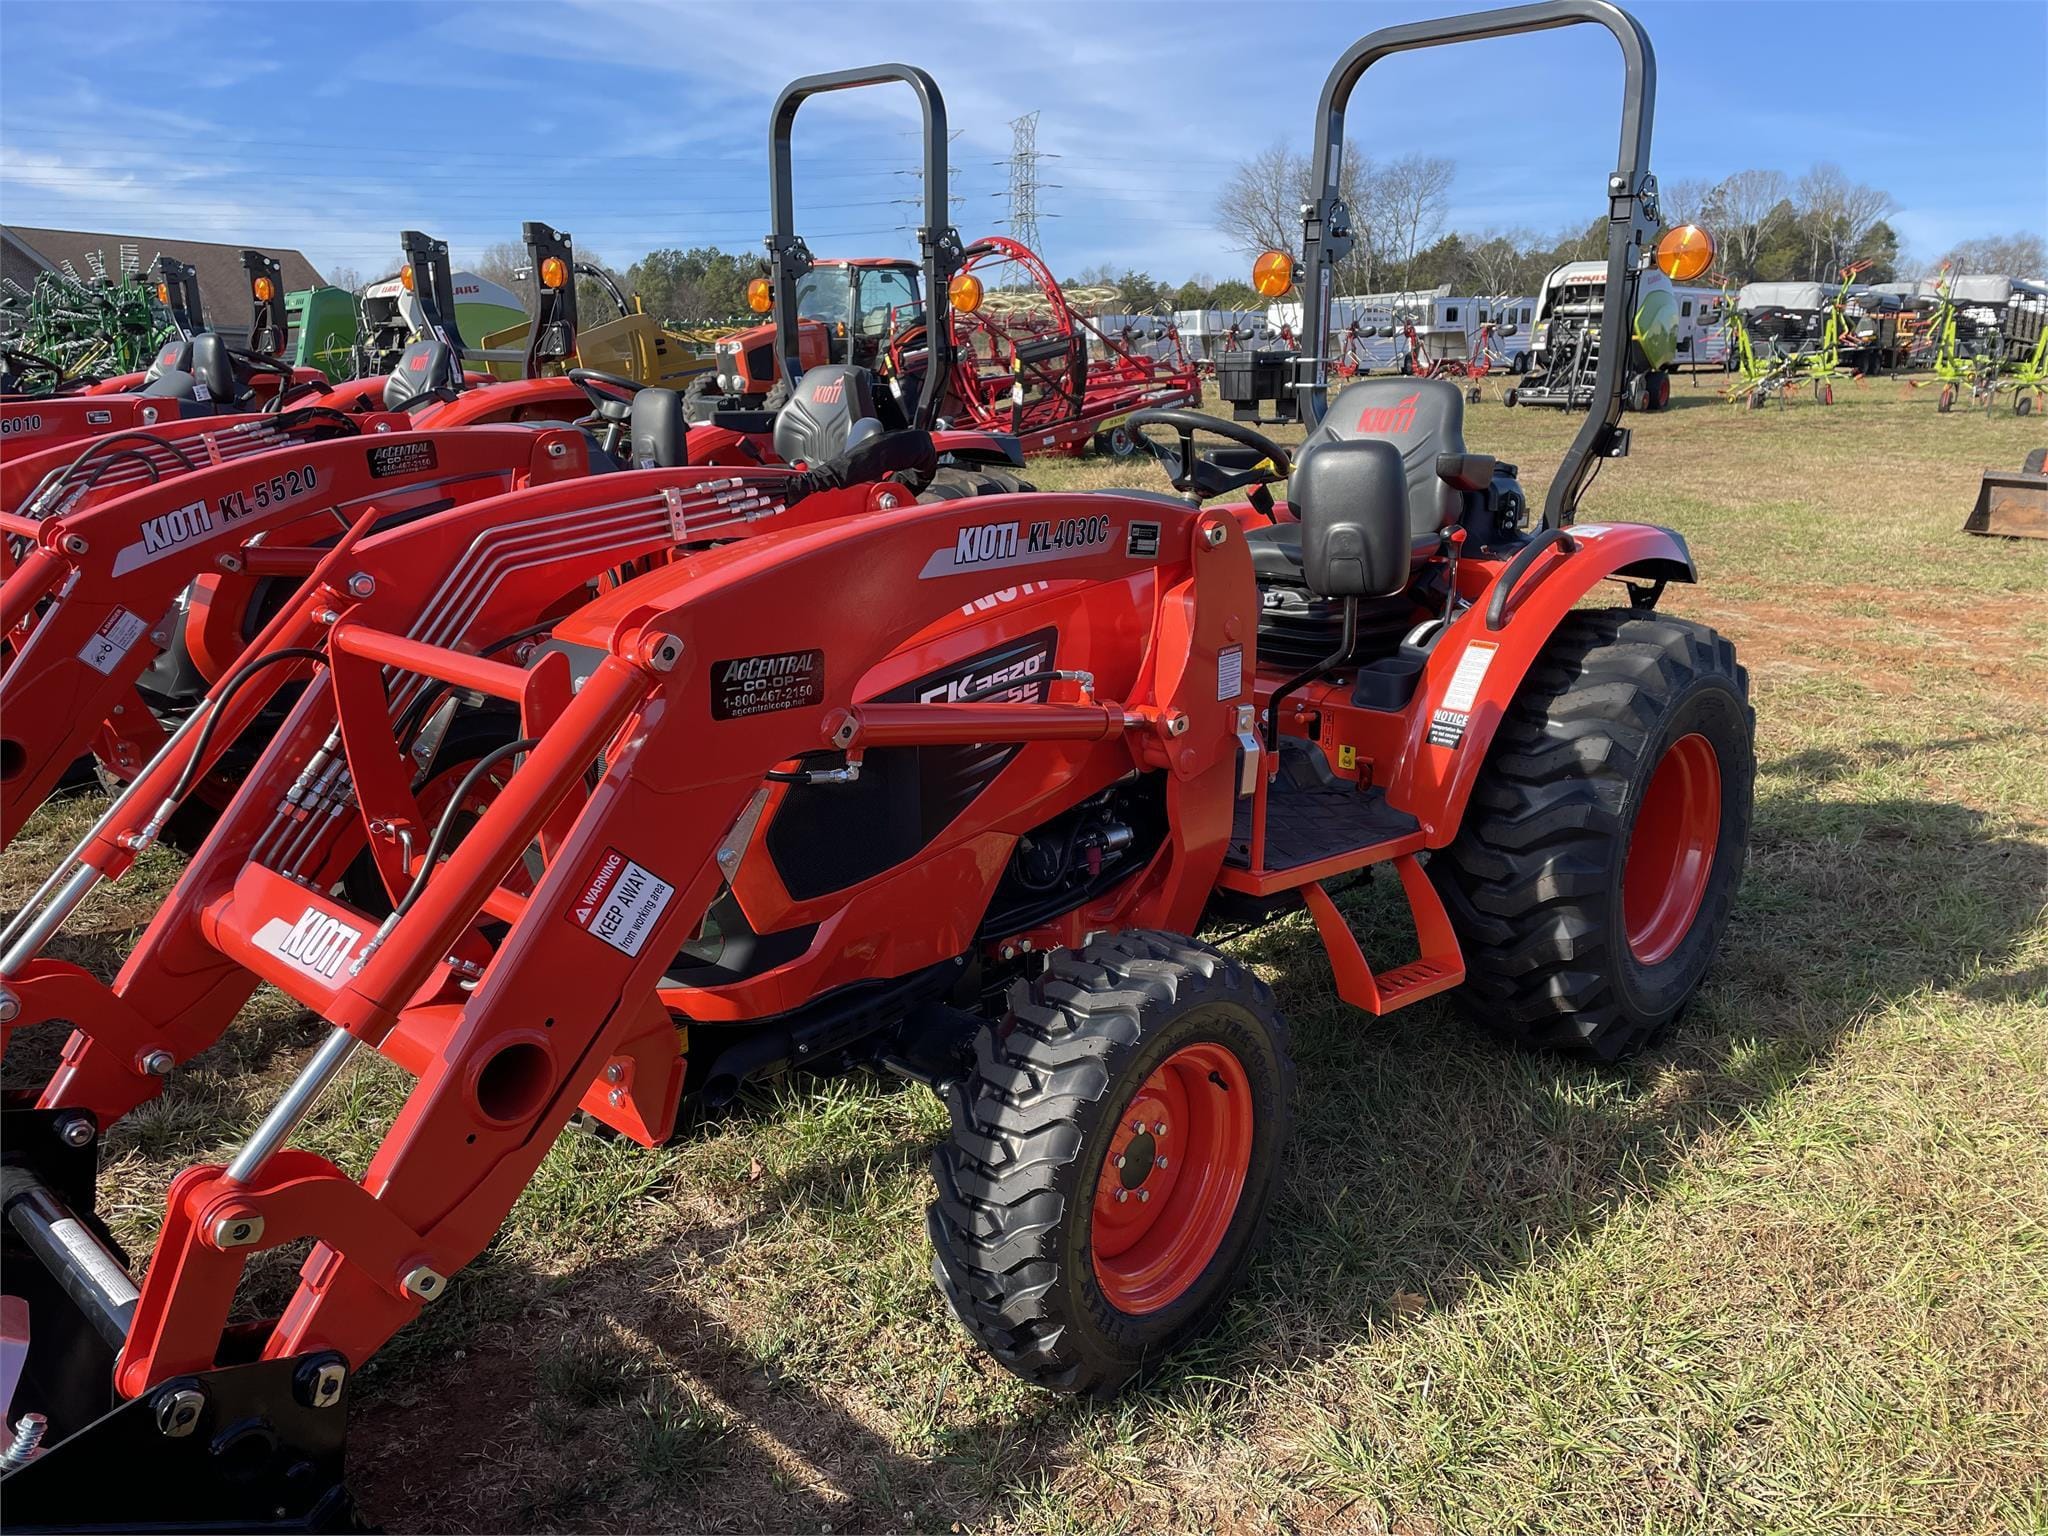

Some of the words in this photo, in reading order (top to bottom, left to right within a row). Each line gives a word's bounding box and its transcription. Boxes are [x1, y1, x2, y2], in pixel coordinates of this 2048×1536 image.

[813, 384, 842, 403] KIOTI
[1356, 405, 1418, 433] KIOTI
[141, 498, 213, 554] KIOTI
[954, 520, 1020, 565] KIOTI
[1027, 515, 1110, 553] KL4030C
[723, 684, 813, 709] 1-800-467-2150
[731, 698, 806, 717] agcentralcoop.net
[1433, 709, 1470, 725] NOTICE
[582, 854, 621, 905] WARNING
[596, 905, 624, 940] KEEP
[616, 868, 647, 908] AWAY
[619, 929, 638, 950] from
[632, 900, 656, 931] working
[650, 883, 666, 902] area
[279, 905, 362, 980] KIOTI
